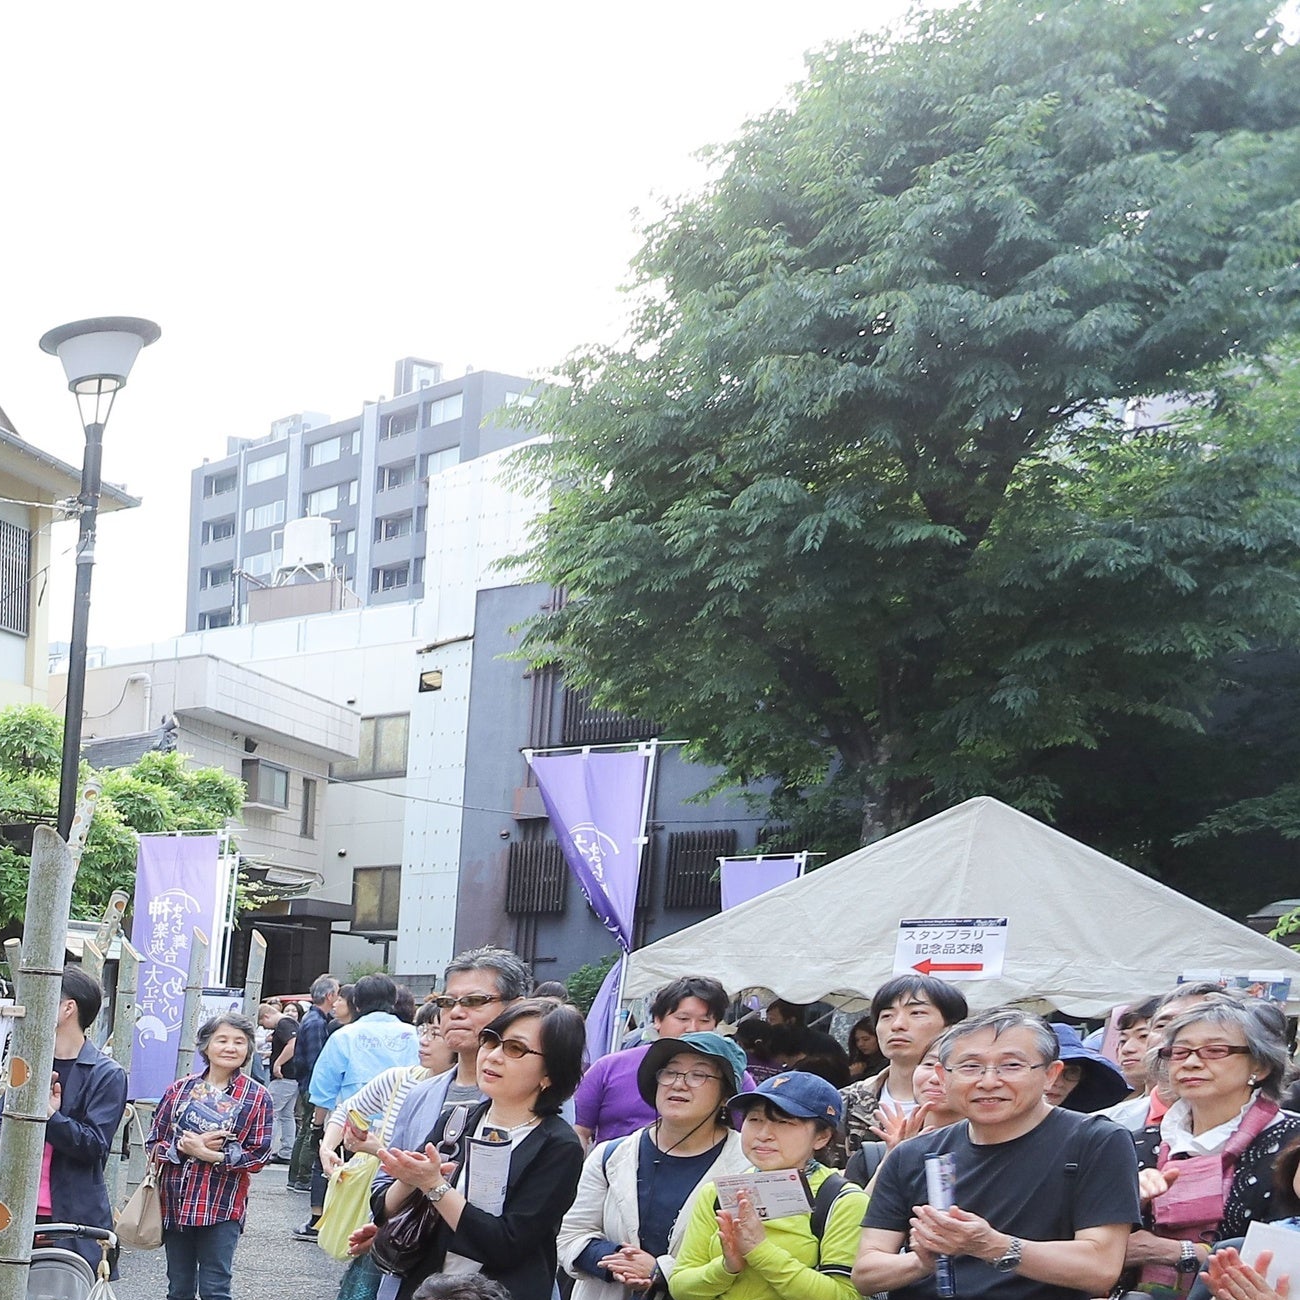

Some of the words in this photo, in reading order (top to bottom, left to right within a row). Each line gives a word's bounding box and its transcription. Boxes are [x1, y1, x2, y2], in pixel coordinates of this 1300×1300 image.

[904, 930, 1000, 941] スタンプラリー
[915, 943, 984, 954] 記念品交換
